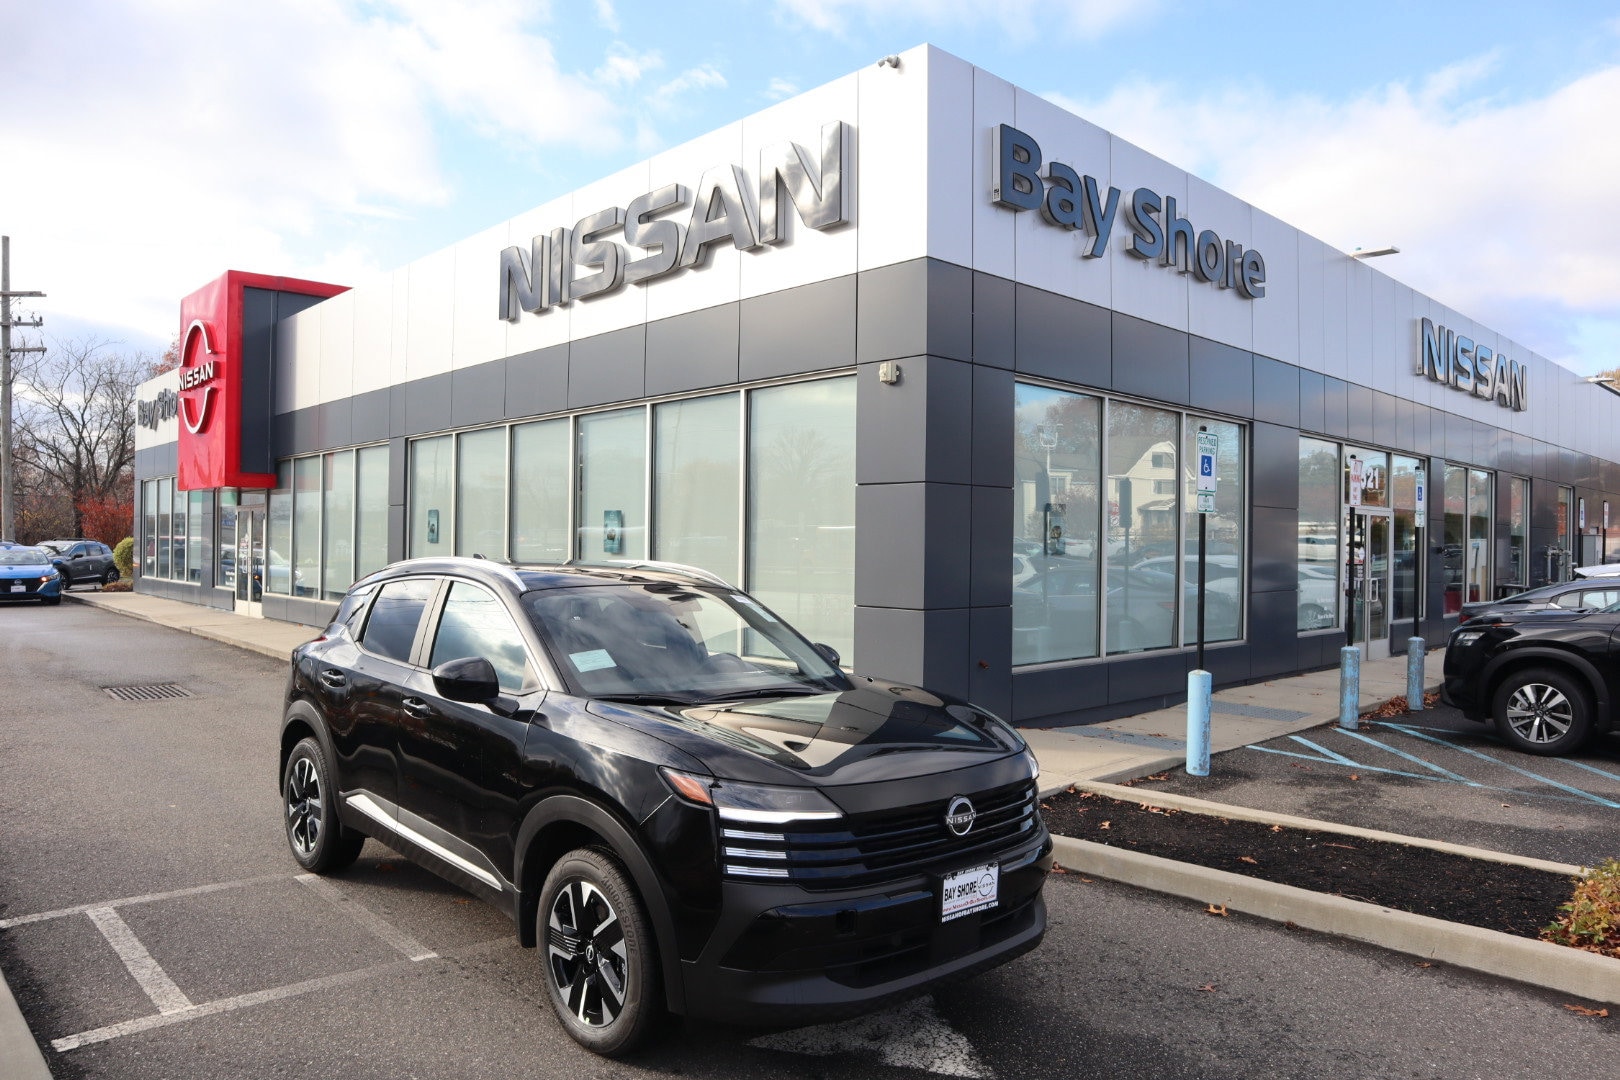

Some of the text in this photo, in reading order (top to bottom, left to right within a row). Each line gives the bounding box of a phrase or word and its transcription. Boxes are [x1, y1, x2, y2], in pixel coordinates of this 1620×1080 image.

[498, 119, 856, 322] NISSAN
[992, 123, 1266, 299] Bay Shore
[179, 361, 214, 391] NISSAN
[1416, 316, 1527, 412] NISSAN
[138, 388, 179, 432] Bay Sho
[946, 811, 976, 824] NISSAN
[944, 886, 957, 901] BAY
[957, 881, 977, 898] SHORE
